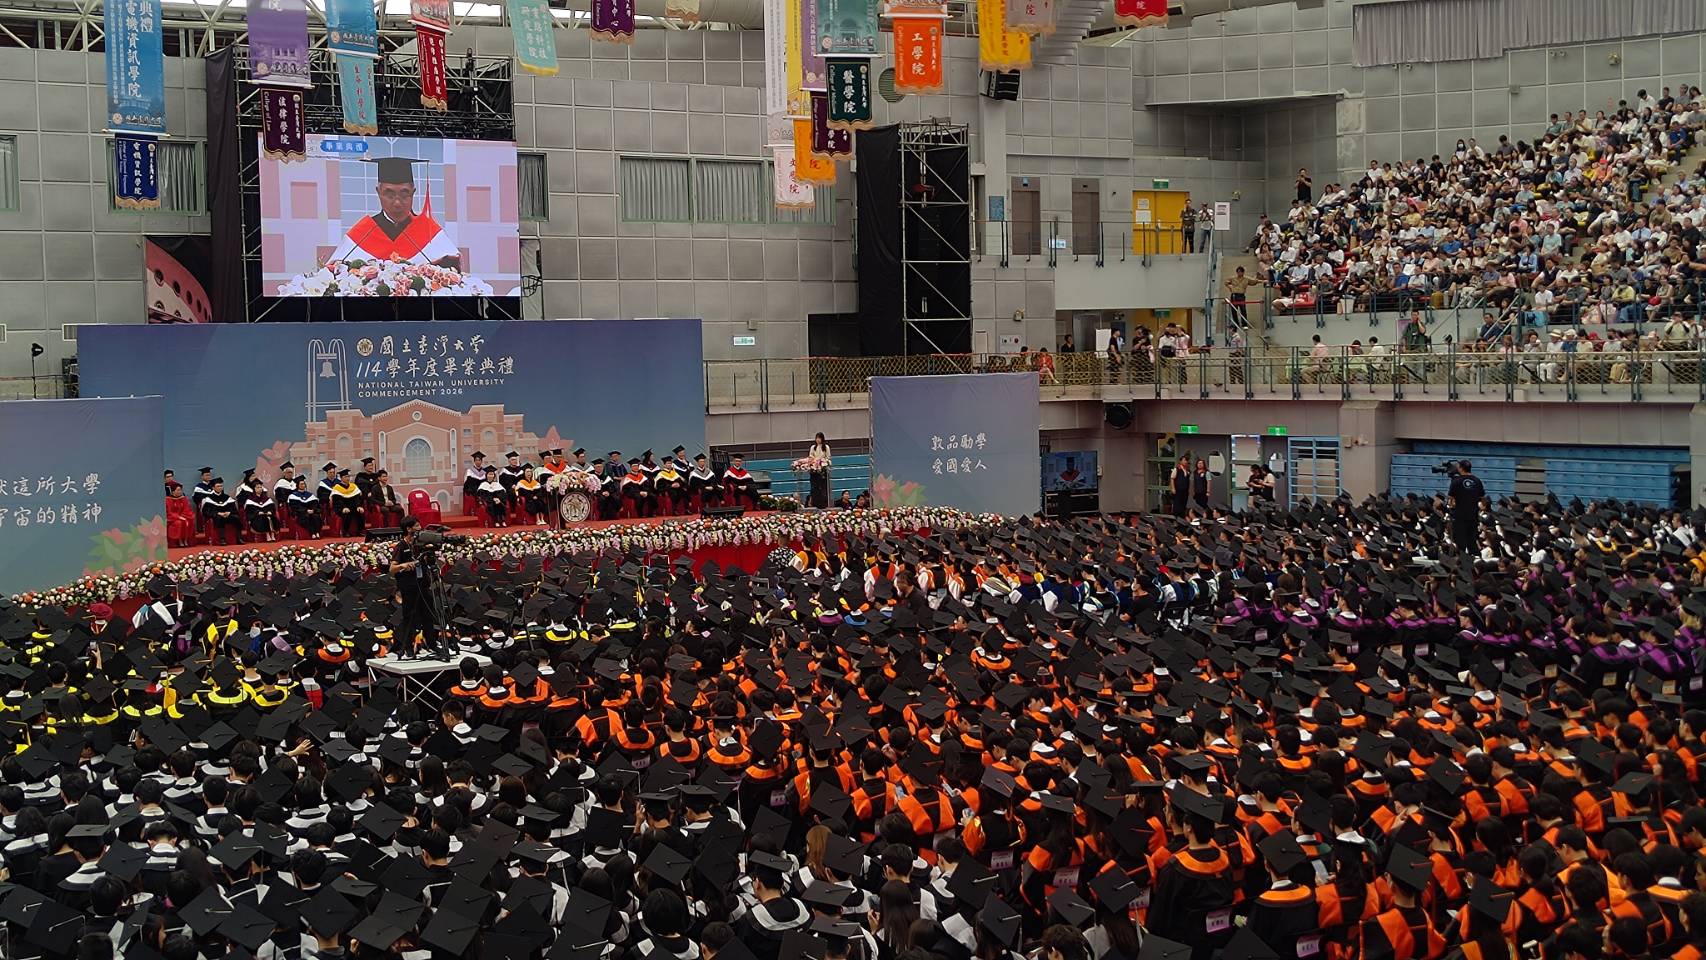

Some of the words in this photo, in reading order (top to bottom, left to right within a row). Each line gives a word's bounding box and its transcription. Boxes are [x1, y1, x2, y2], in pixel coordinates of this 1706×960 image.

[126, 1, 142, 97] 電機資訊學院
[912, 32, 925, 75] 工學院
[843, 70, 856, 113] 醫學院
[278, 96, 290, 145] 法律學院
[133, 142, 142, 195] 電機資訊學院
[356, 356, 514, 378] 114學年度畢業典禮
[358, 381, 405, 389] NATIONAL
[451, 378, 505, 386] UNIVERSITY
[358, 389, 437, 398] COMMENCEMENT
[441, 388, 463, 396] 2026
[931, 432, 986, 450] 敦品勵學
[932, 457, 987, 474] 愛國愛人
